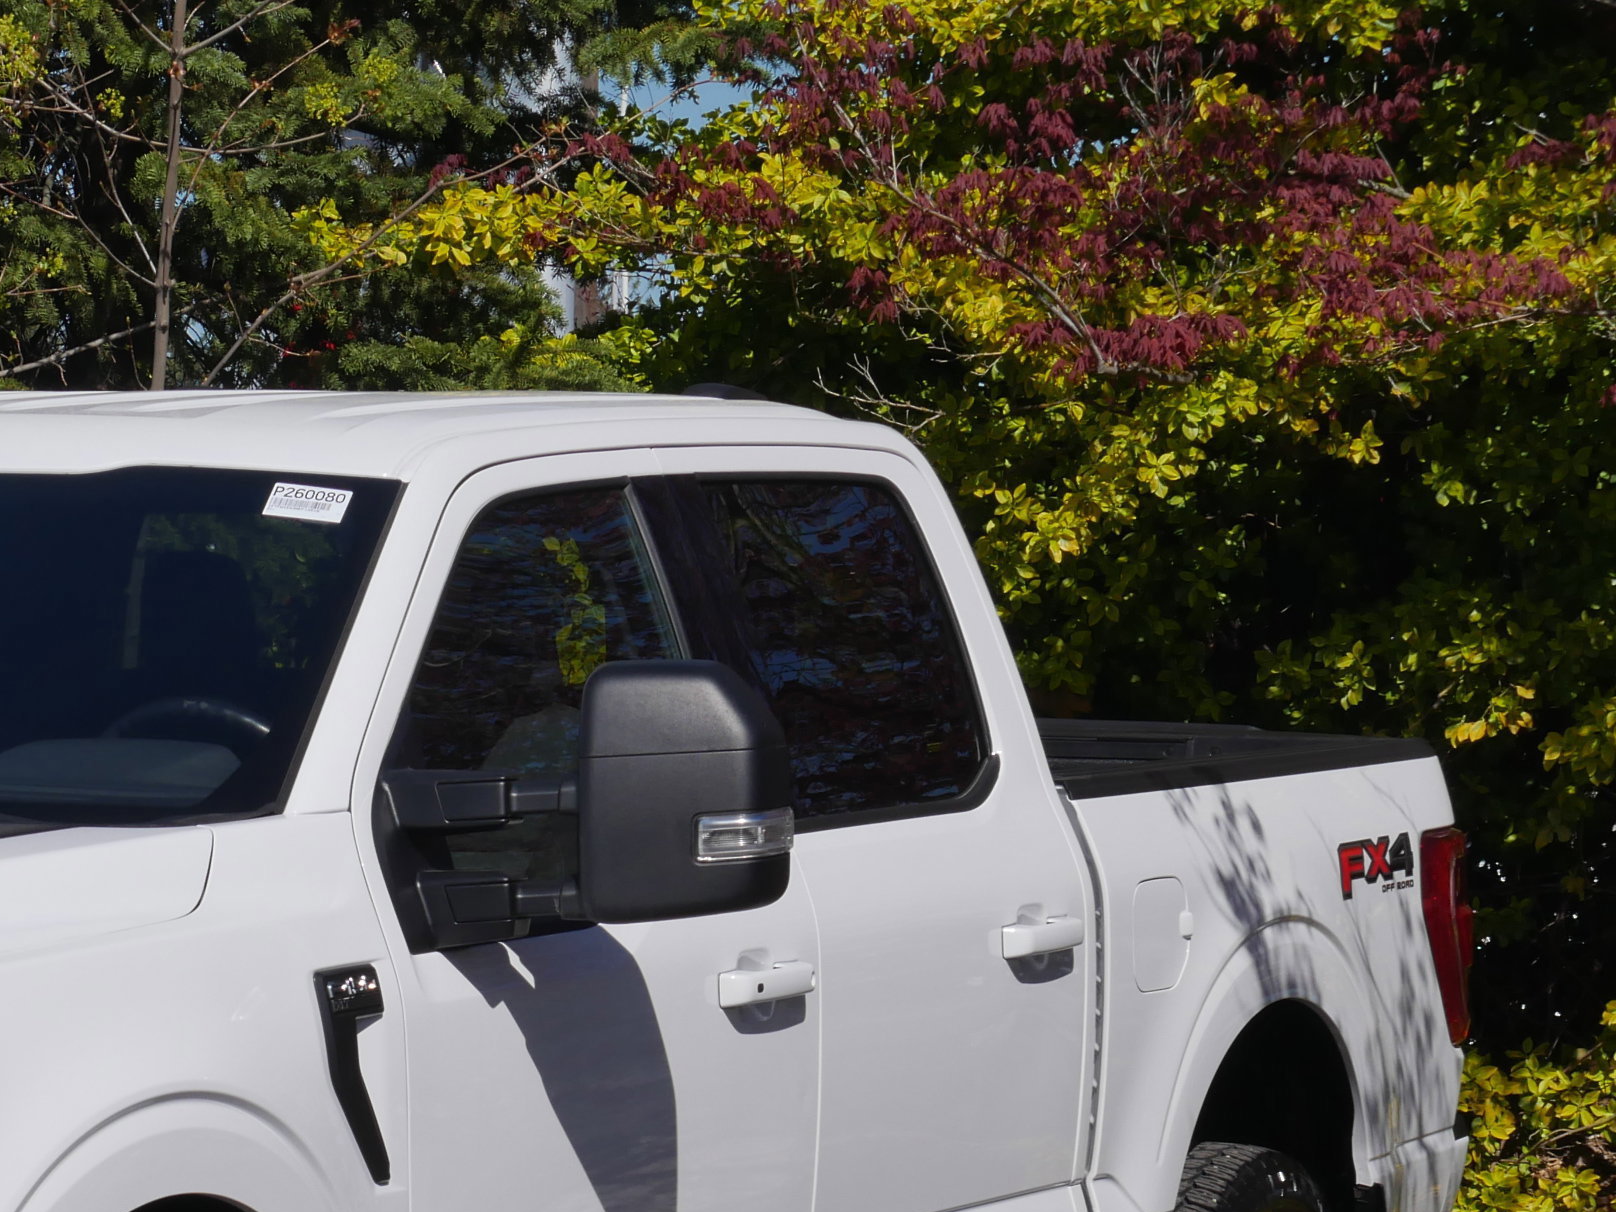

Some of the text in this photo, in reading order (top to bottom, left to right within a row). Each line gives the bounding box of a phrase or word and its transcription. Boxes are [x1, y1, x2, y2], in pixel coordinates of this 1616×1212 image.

[273, 486, 346, 503] P260080
[1337, 832, 1414, 900] FX4
[1382, 879, 1414, 893] OFF ROAD
